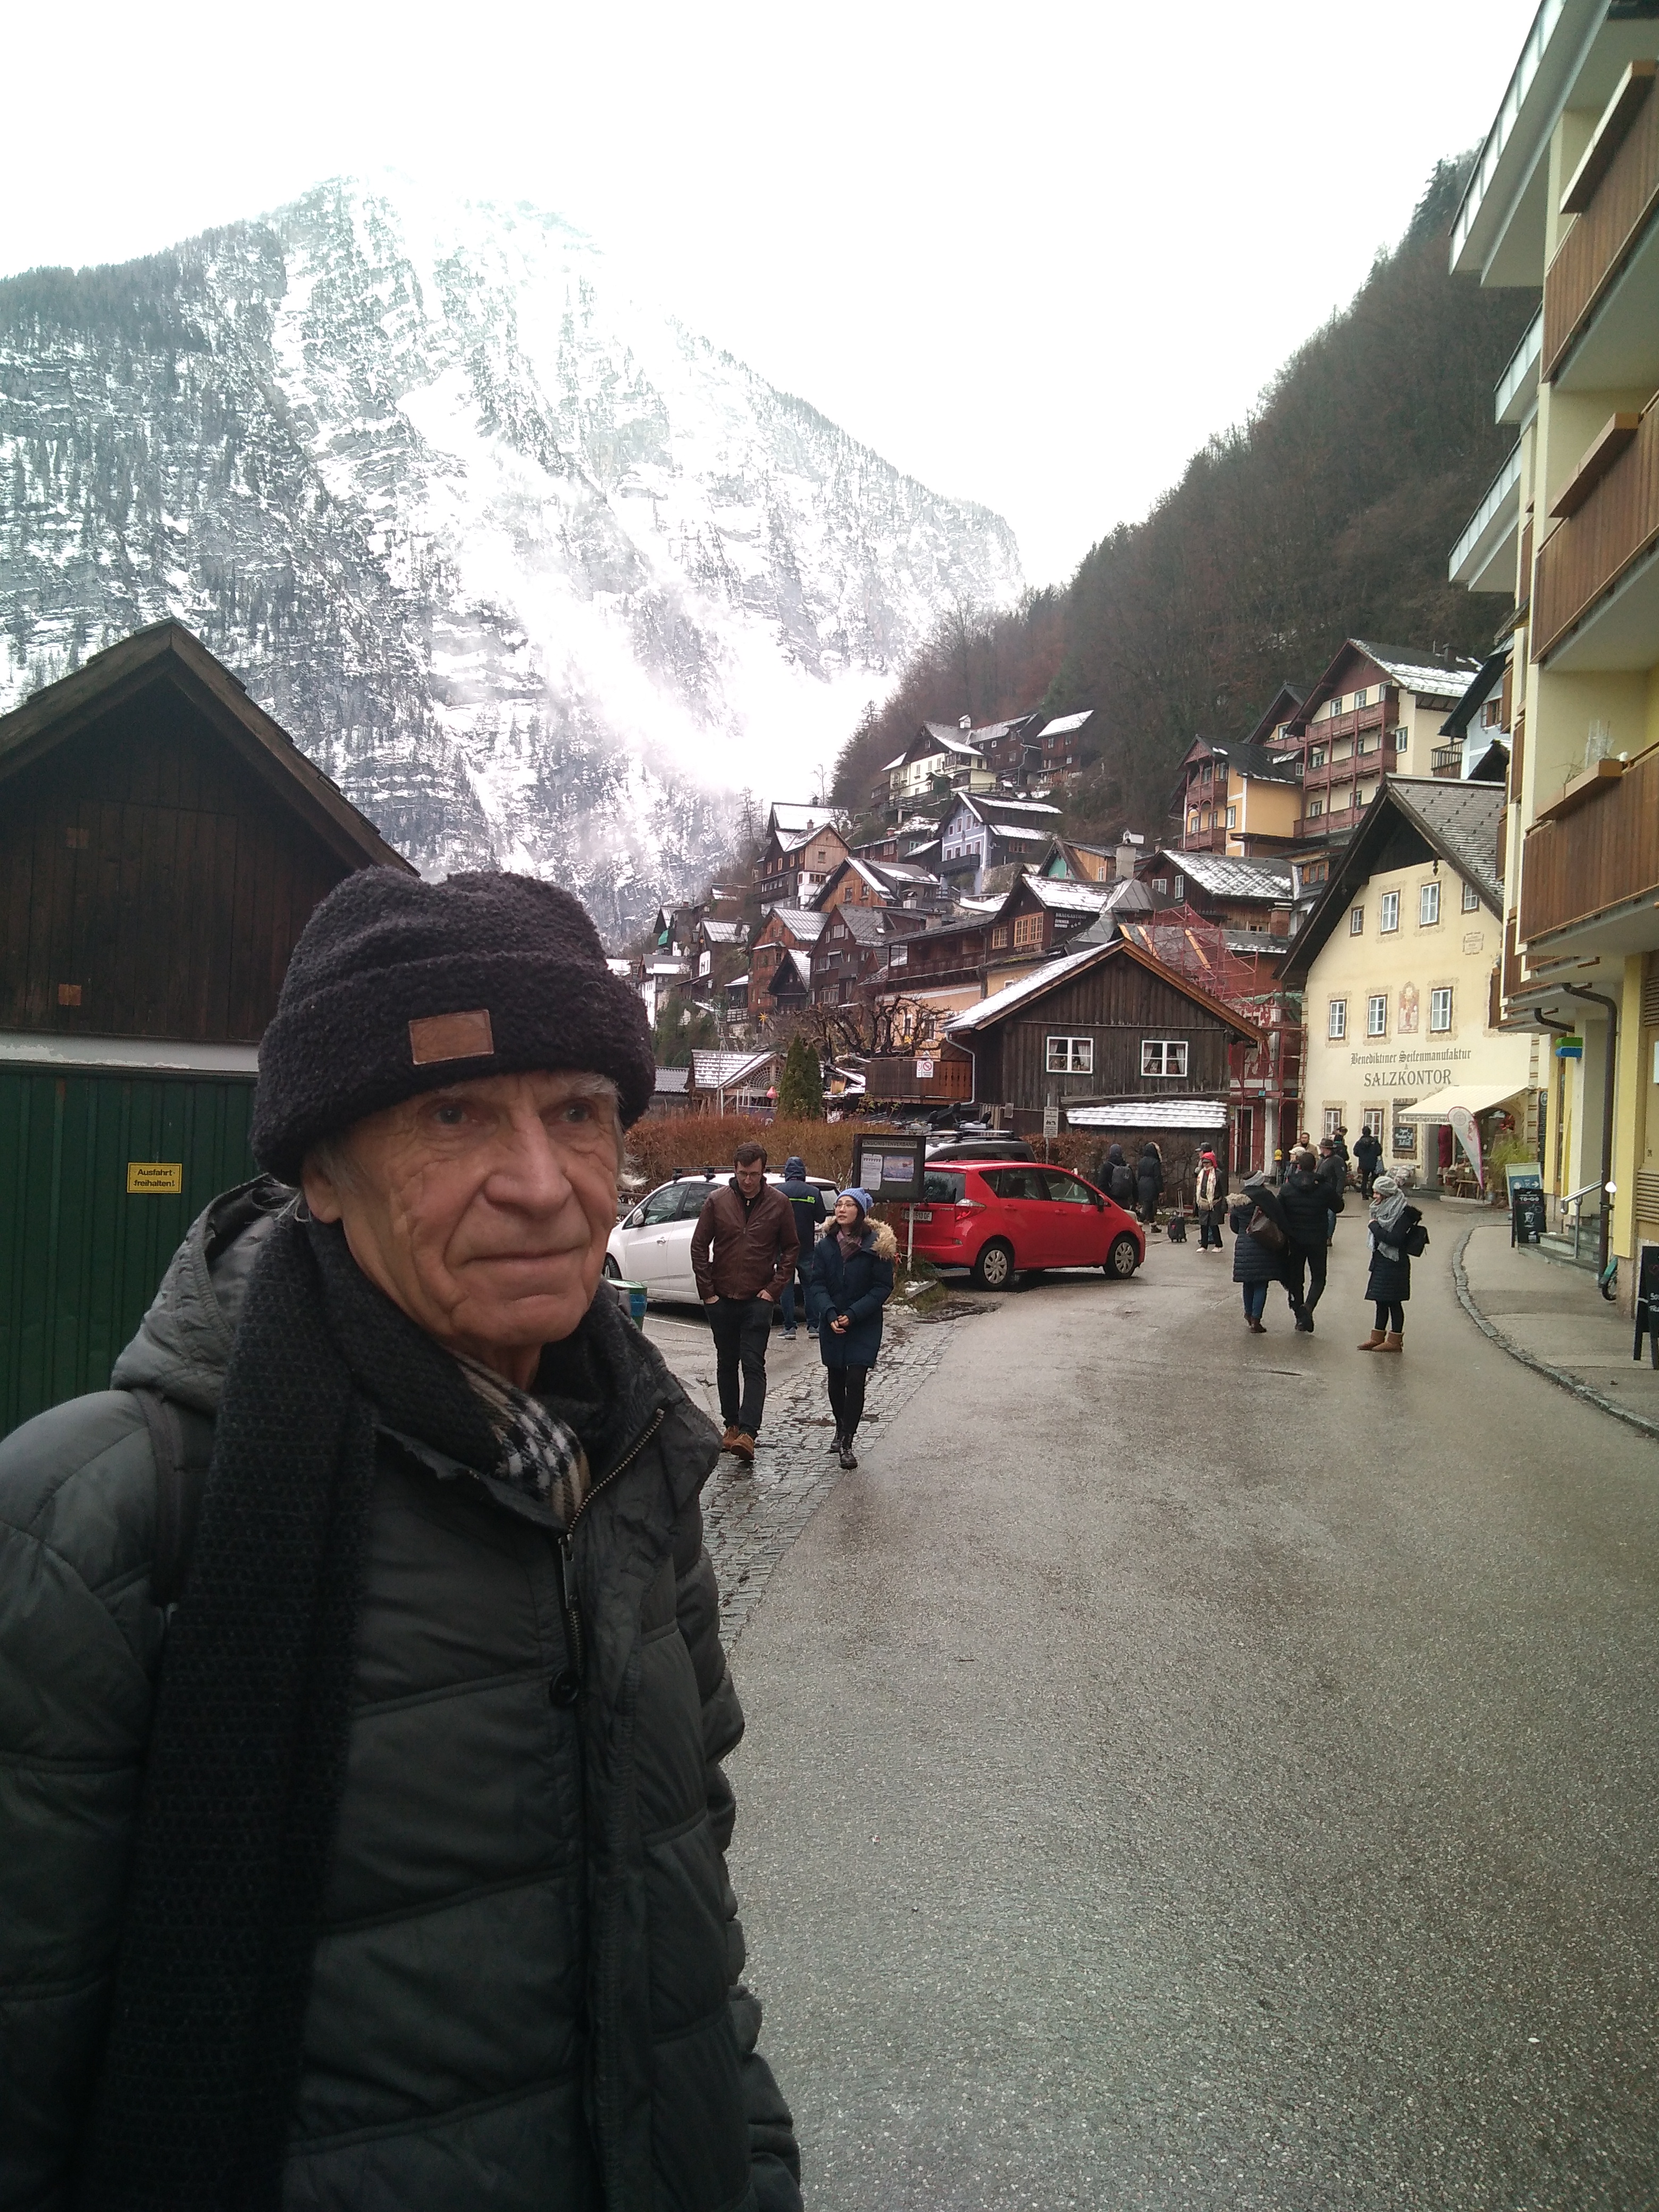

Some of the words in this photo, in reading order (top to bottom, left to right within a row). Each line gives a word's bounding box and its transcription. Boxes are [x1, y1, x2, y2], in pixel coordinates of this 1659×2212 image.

[1351, 1052, 1397, 1065] Benediktiner
[1398, 1048, 1471, 1062] Seifenmanufaktur
[1364, 1069, 1451, 1086] SALZKONTOR
